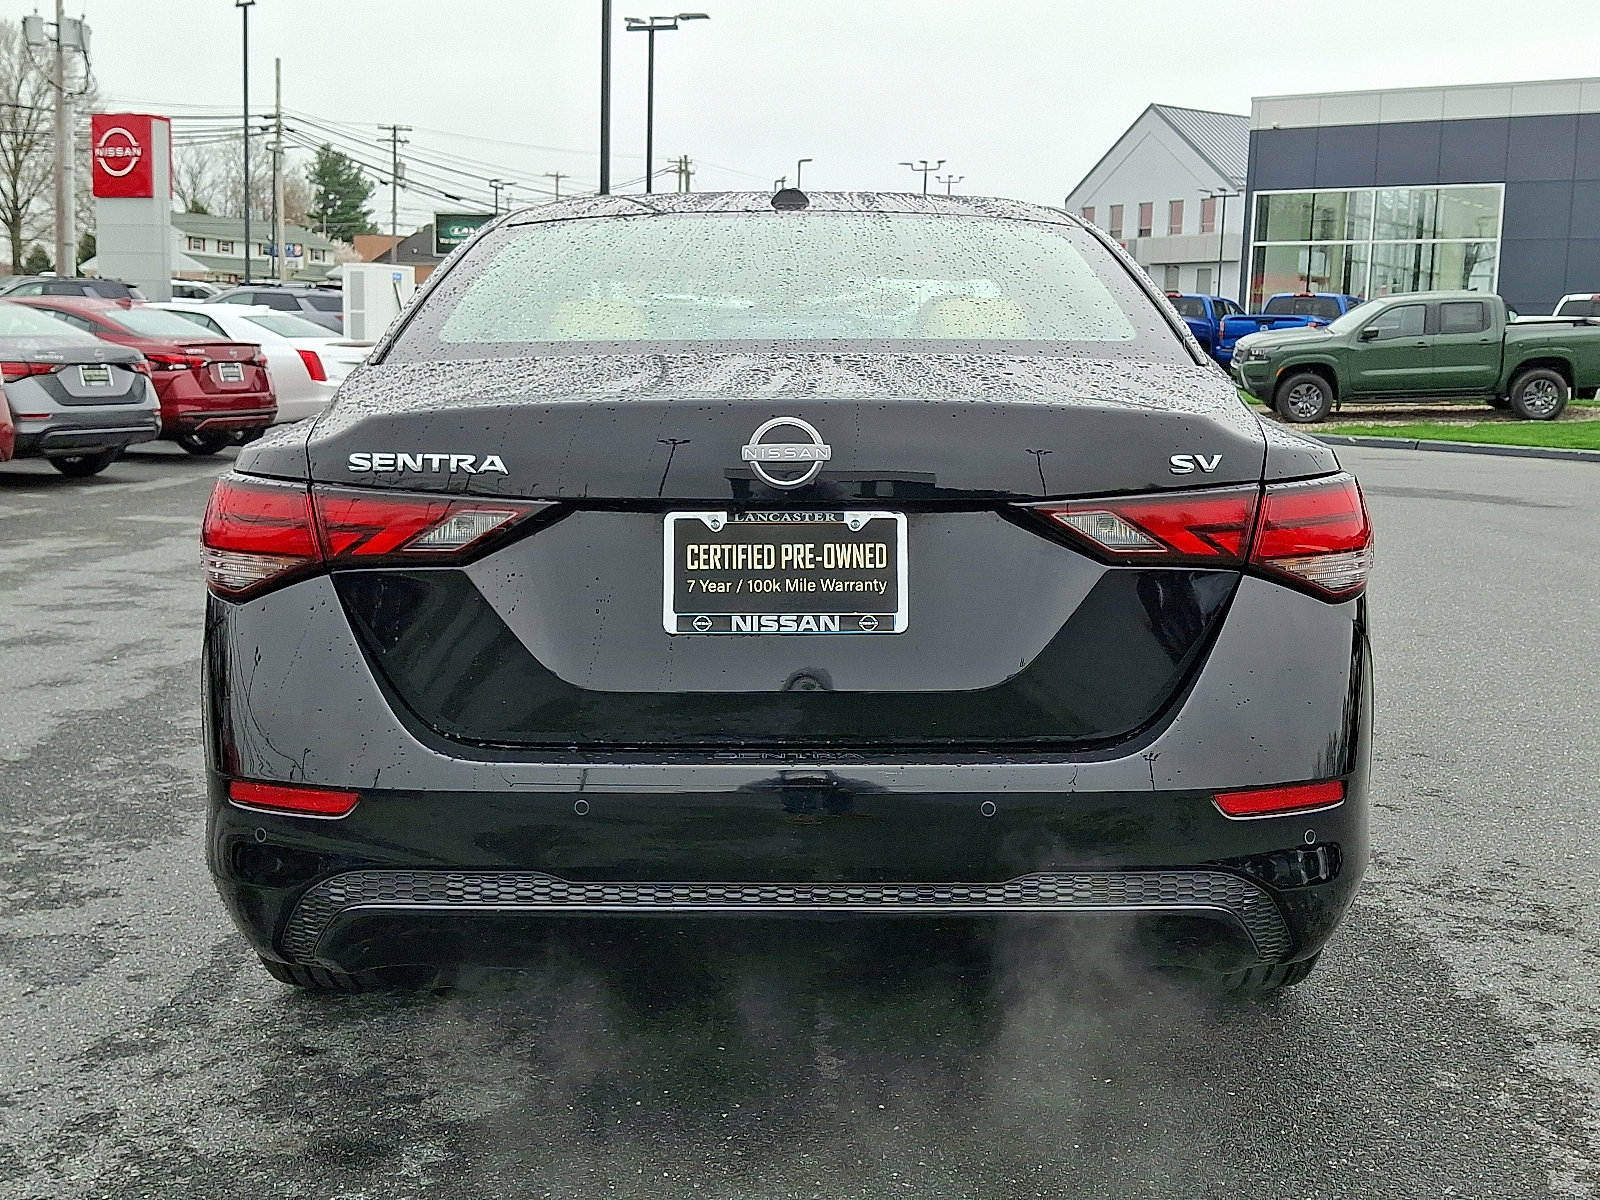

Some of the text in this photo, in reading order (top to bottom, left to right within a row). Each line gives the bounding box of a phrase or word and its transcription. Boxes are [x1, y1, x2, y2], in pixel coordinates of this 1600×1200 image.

[94, 146, 142, 158] NISSAN
[744, 447, 829, 459] NISSAN
[348, 452, 509, 475] SENTRA
[1169, 453, 1223, 474] SV
[734, 512, 837, 522] LANCASTER
[686, 543, 887, 570] CERTIFIED PRE-OWNED
[686, 577, 888, 595] 7 Year / 100k Mile Warranty
[731, 615, 840, 632] NISSAN
